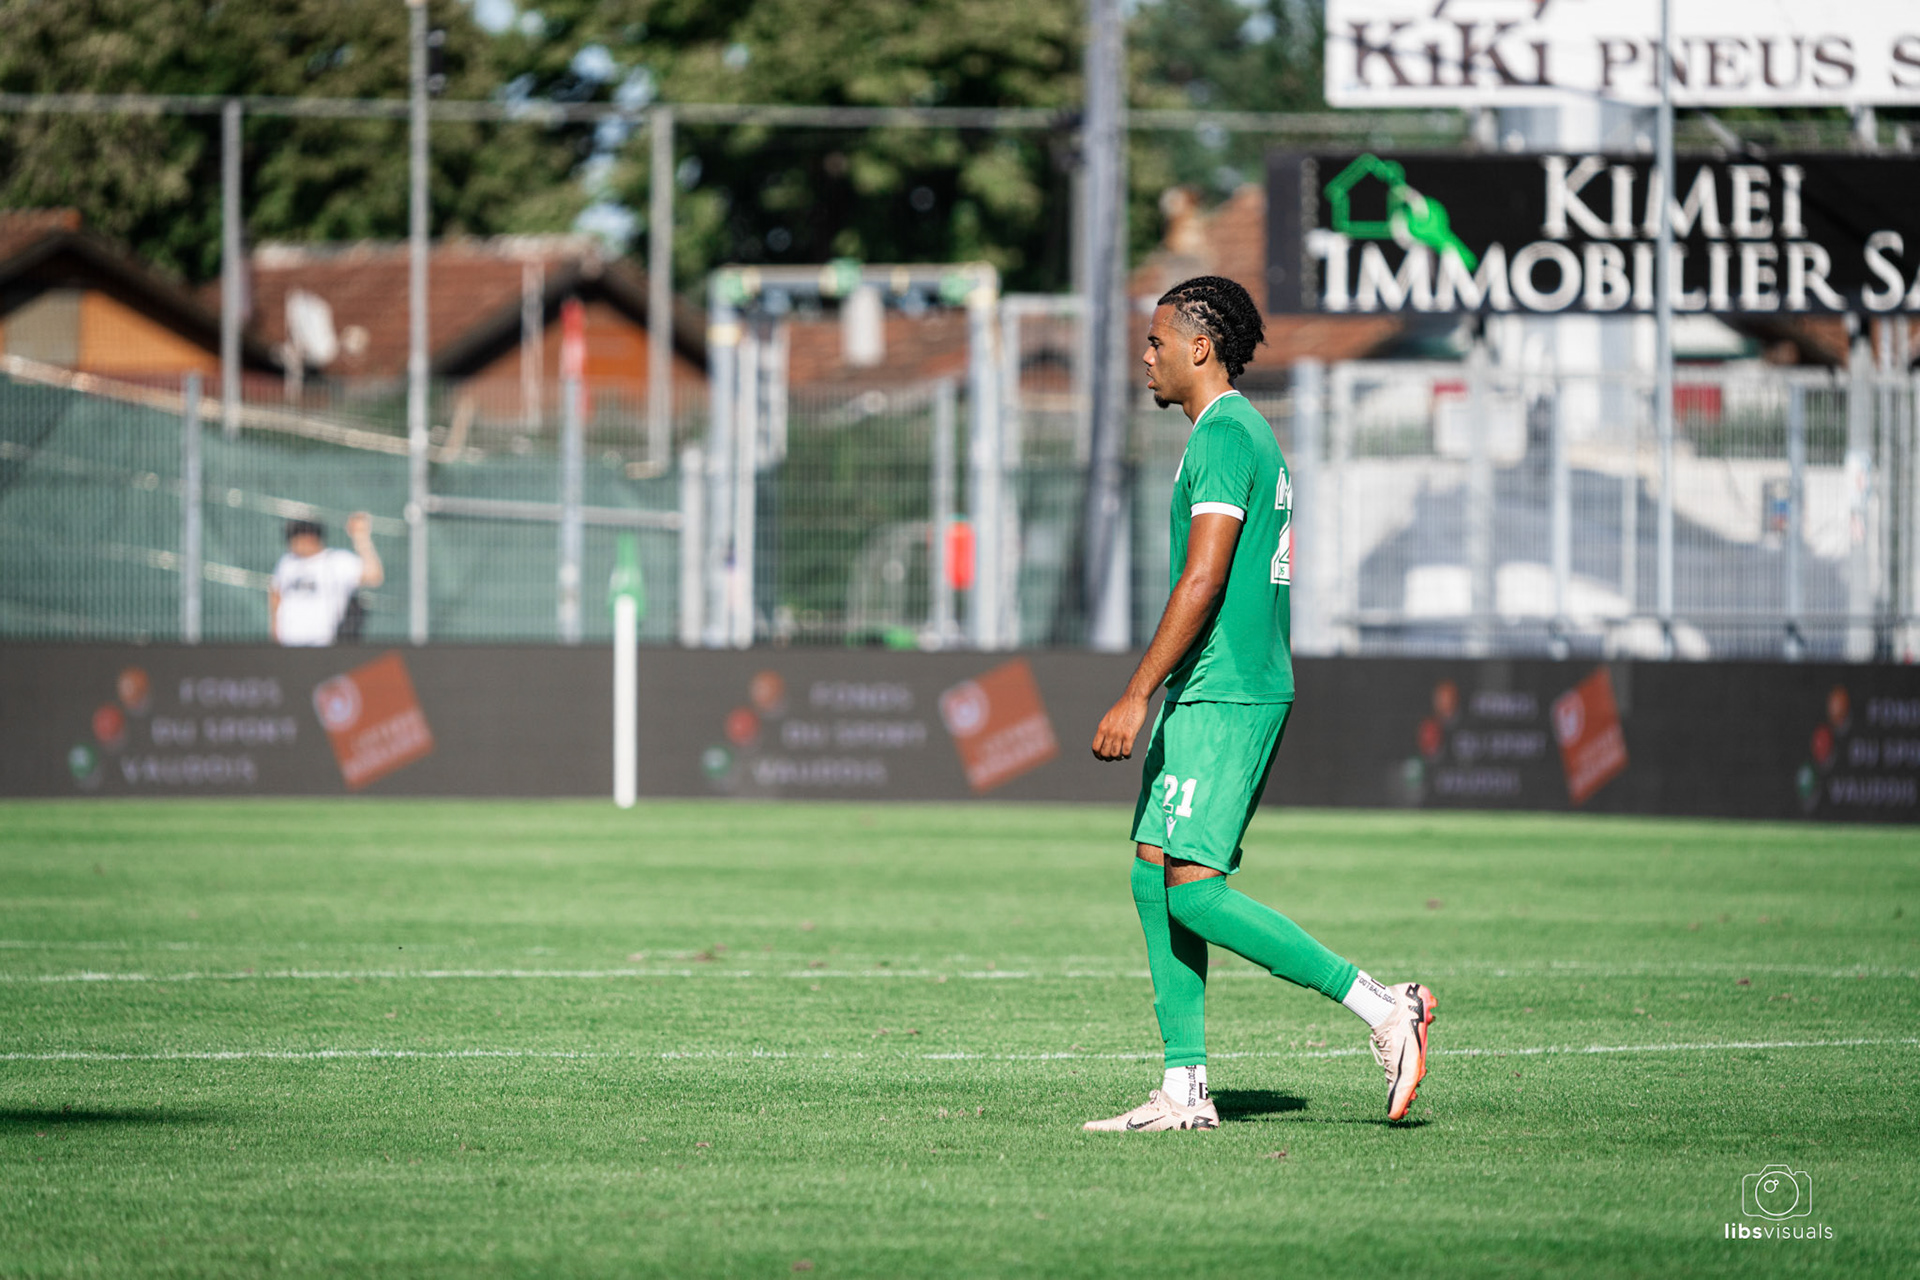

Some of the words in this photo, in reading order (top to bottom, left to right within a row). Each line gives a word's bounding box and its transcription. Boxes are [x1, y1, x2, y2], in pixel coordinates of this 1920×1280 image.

[1596, 36, 1857, 89] PNEUS
[1542, 155, 1807, 239] KIMEI
[1306, 230, 1848, 311] IMMOBILIER
[1862, 229, 1920, 312] S
[1163, 774, 1197, 818] 21
